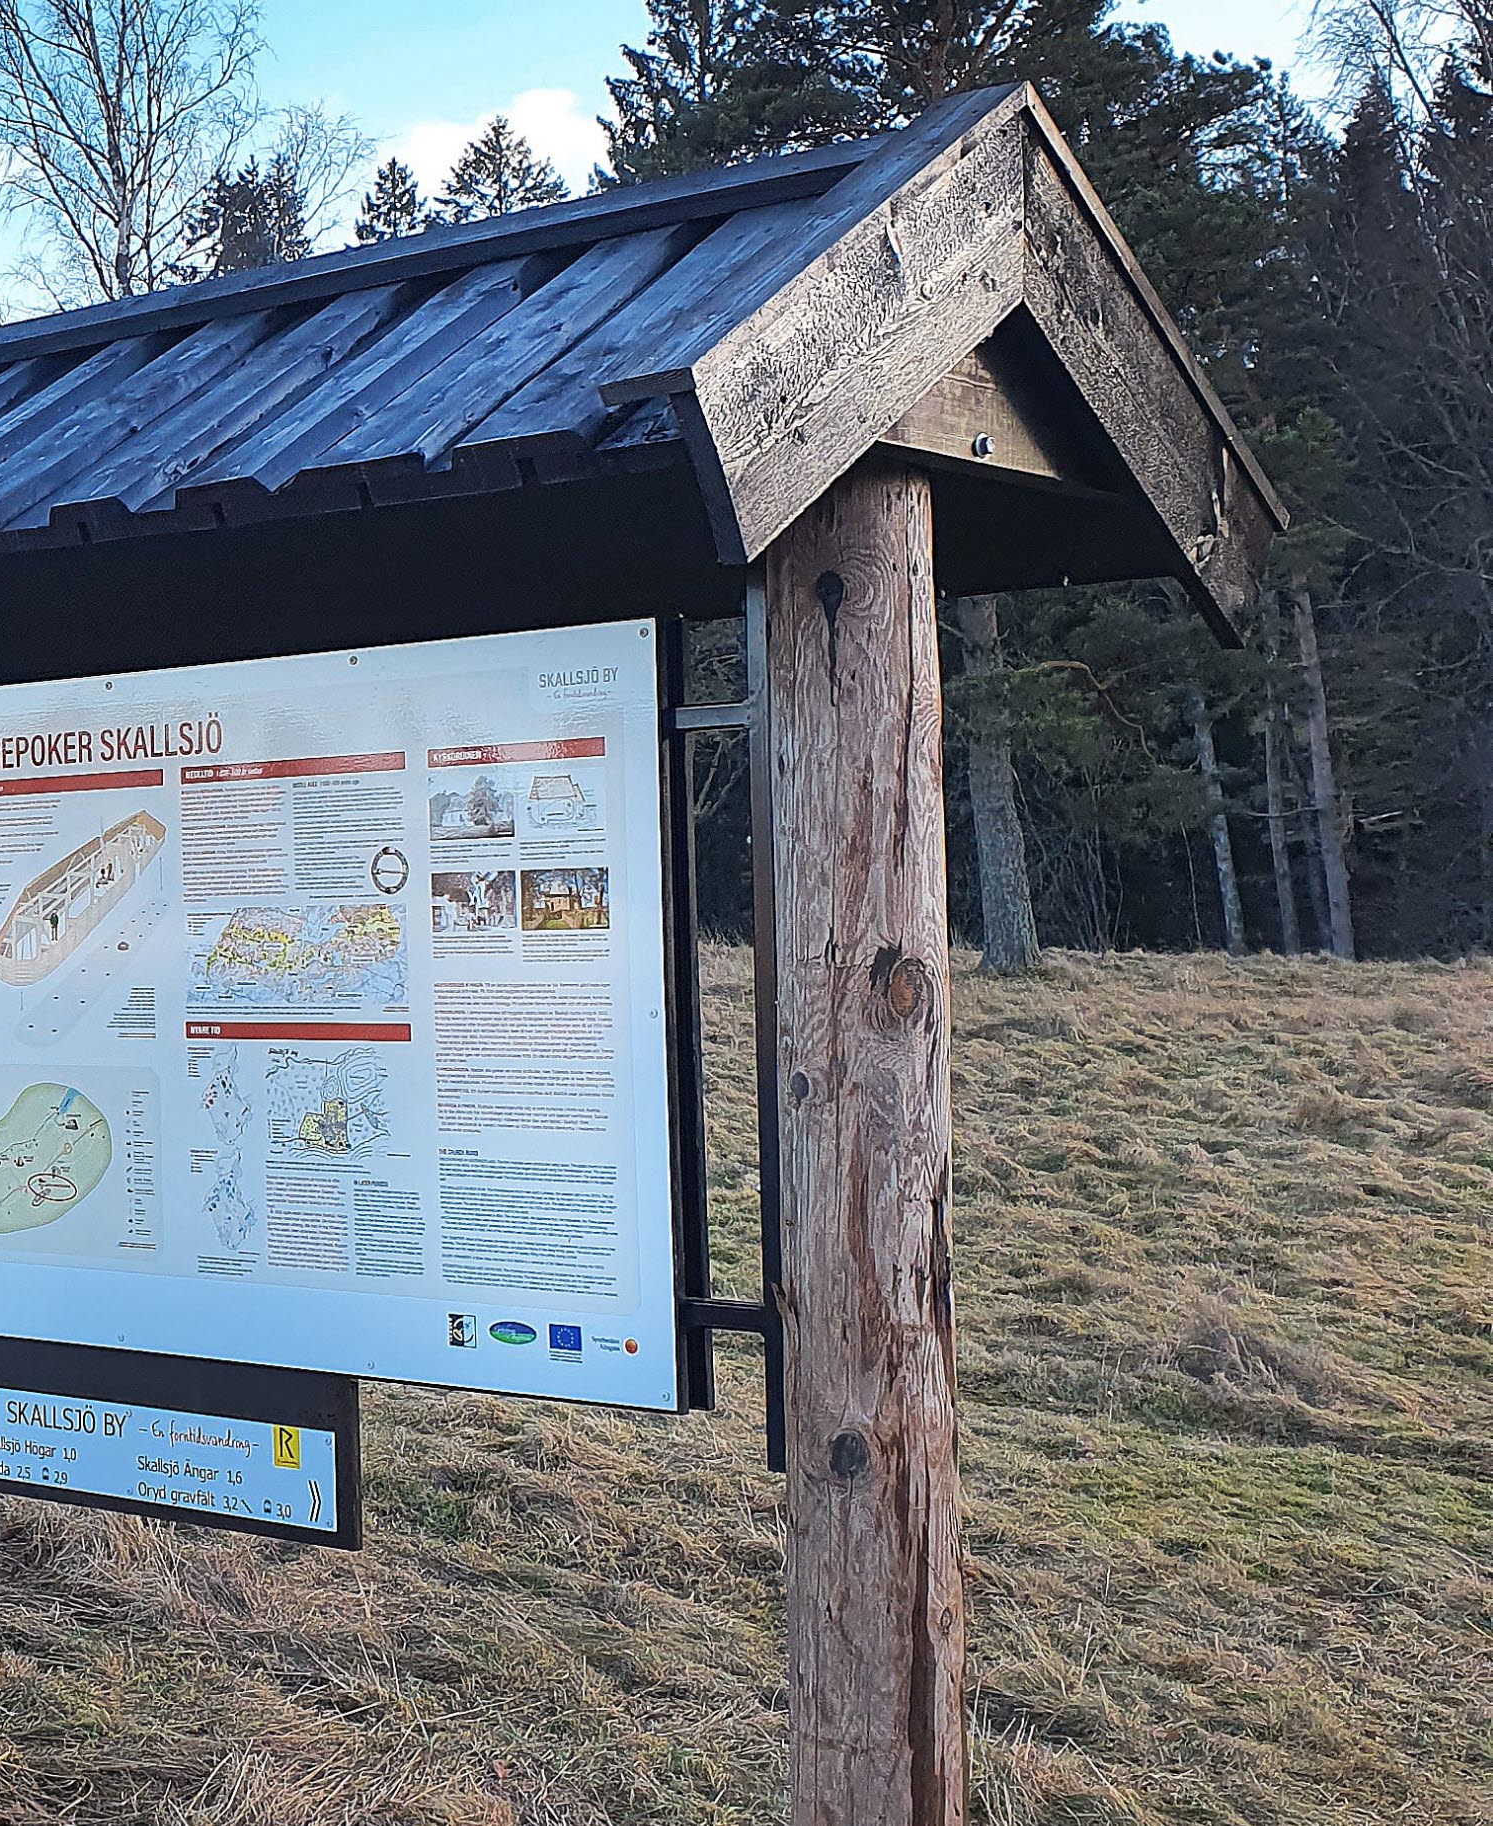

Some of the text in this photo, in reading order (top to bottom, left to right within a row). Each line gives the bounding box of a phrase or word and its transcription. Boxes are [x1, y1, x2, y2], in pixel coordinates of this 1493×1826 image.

[539, 666, 619, 688] SKALLSJÖ BY
[100, 712, 223, 761] SKALLSJÖ
[7, 1400, 96, 1434] SKALLSJÖ
[104, 1411, 127, 1438] BY
[150, 1420, 164, 1438] En
[24, 1440, 57, 1460] Högar
[63, 1447, 77, 1463] 1,0
[16, 1465, 31, 1480] 2,5
[54, 1470, 68, 1486] 2,9
[137, 1455, 180, 1479] Skallsjö
[226, 1469, 242, 1487] 1,6
[138, 1481, 292, 1520] Oryd gravfält 3,2 3,0
